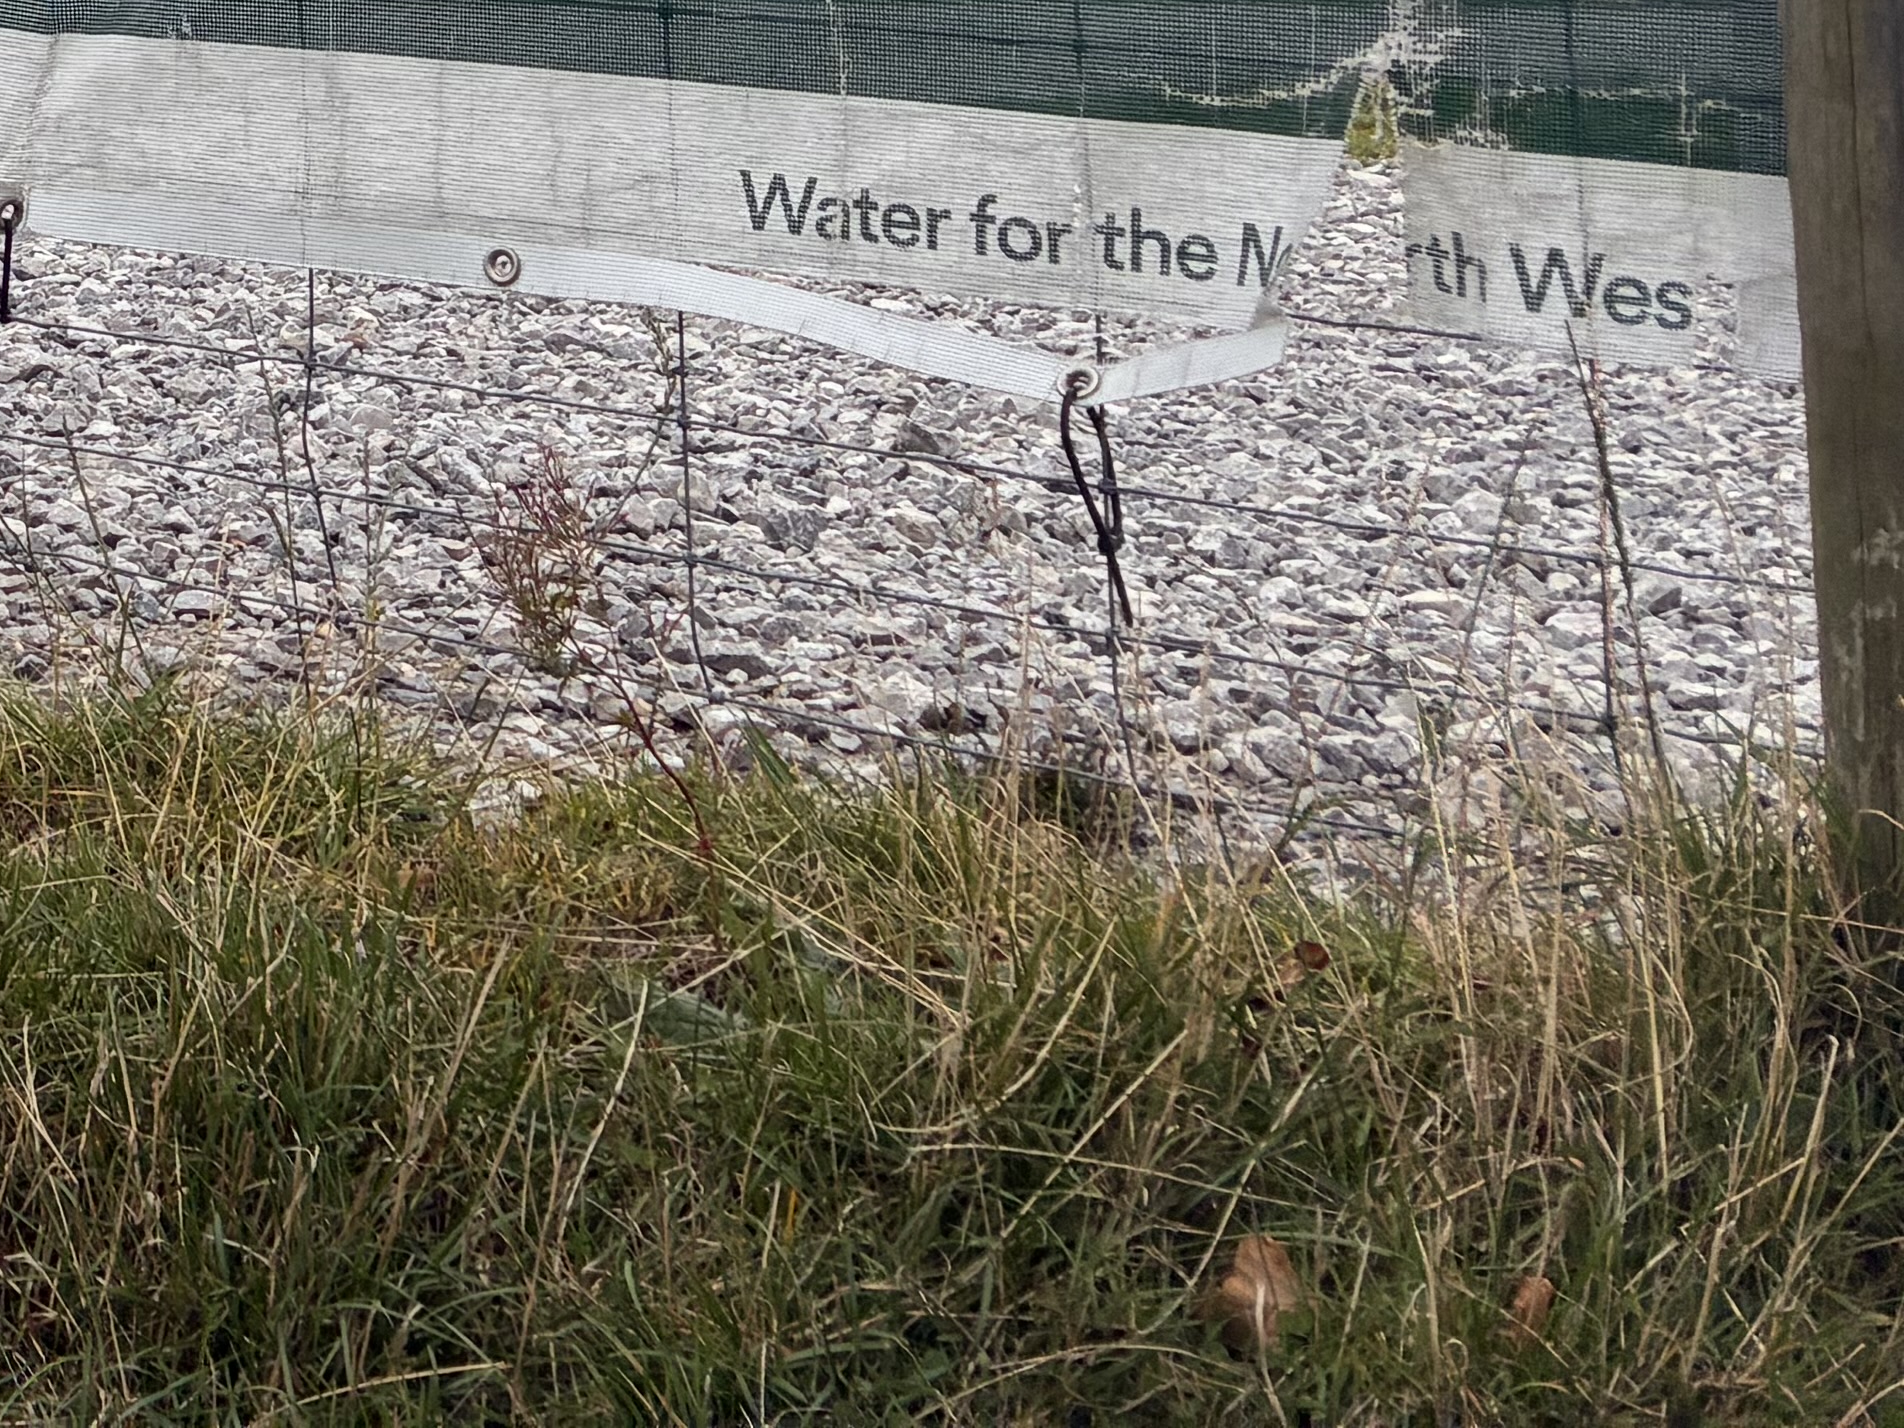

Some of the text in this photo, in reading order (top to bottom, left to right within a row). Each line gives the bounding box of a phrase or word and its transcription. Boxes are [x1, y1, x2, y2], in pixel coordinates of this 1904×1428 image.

[739, 169, 952, 252] Water
[969, 194, 1074, 265] for
[1094, 207, 1220, 282] the
